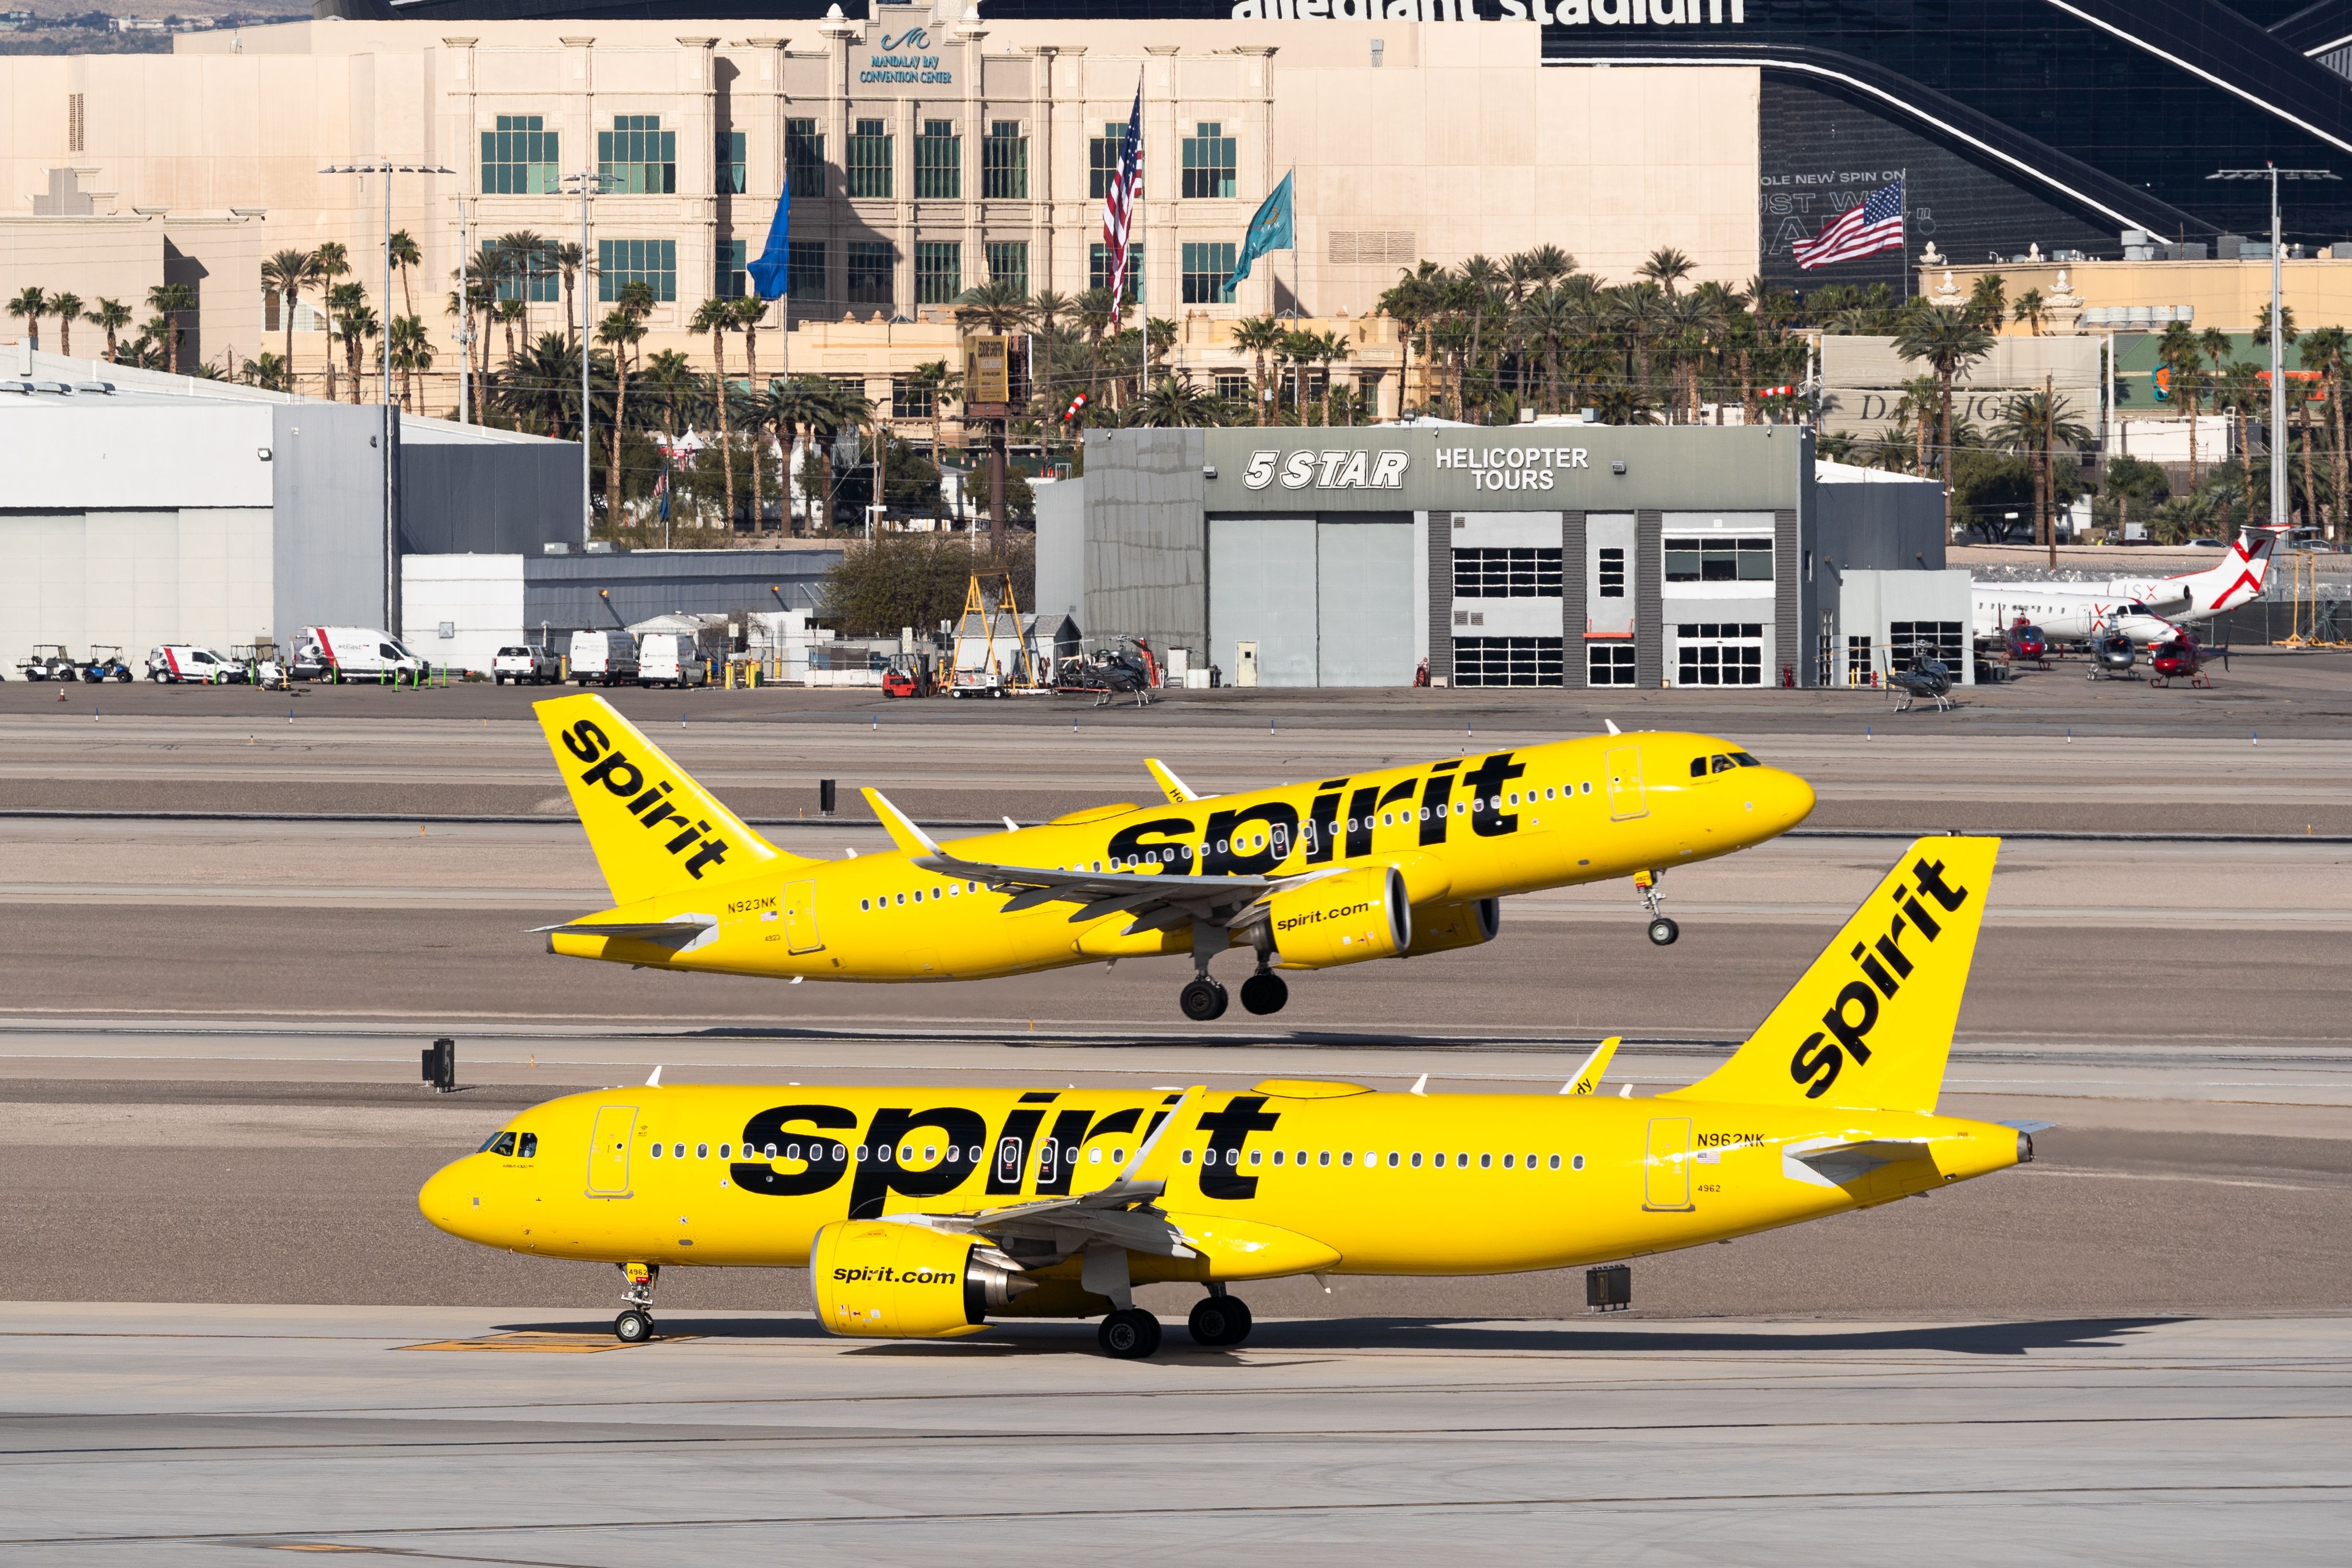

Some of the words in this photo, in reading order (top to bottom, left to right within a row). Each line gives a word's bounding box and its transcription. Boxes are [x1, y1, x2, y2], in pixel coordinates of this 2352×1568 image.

[872, 56, 920, 70] MANDALAY
[922, 56, 939, 70] BAY
[860, 71, 919, 83] CONVENTION
[920, 72, 952, 84] CENTER
[1795, 173, 1834, 185] NEW
[1839, 171, 1877, 182] SPIN
[1881, 170, 1904, 181] ON
[979, 341, 990, 358] EDDIE
[990, 341, 1004, 357] GRIFFIN
[1436, 448, 1588, 468] HELICOPTER
[1242, 449, 1280, 490] 5
[1280, 449, 1410, 490] STAR
[1471, 469, 1554, 490] TOURS
[562, 720, 728, 880] spirit
[1108, 753, 1526, 876] spirit
[728, 896, 776, 914] N923NK
[1277, 902, 1369, 931] spirit.com
[1791, 858, 1968, 1099] spirit
[1697, 1134, 1765, 1147] N962NK
[730, 1092, 1281, 1220] spirit
[833, 1267, 955, 1284] spirit.com
